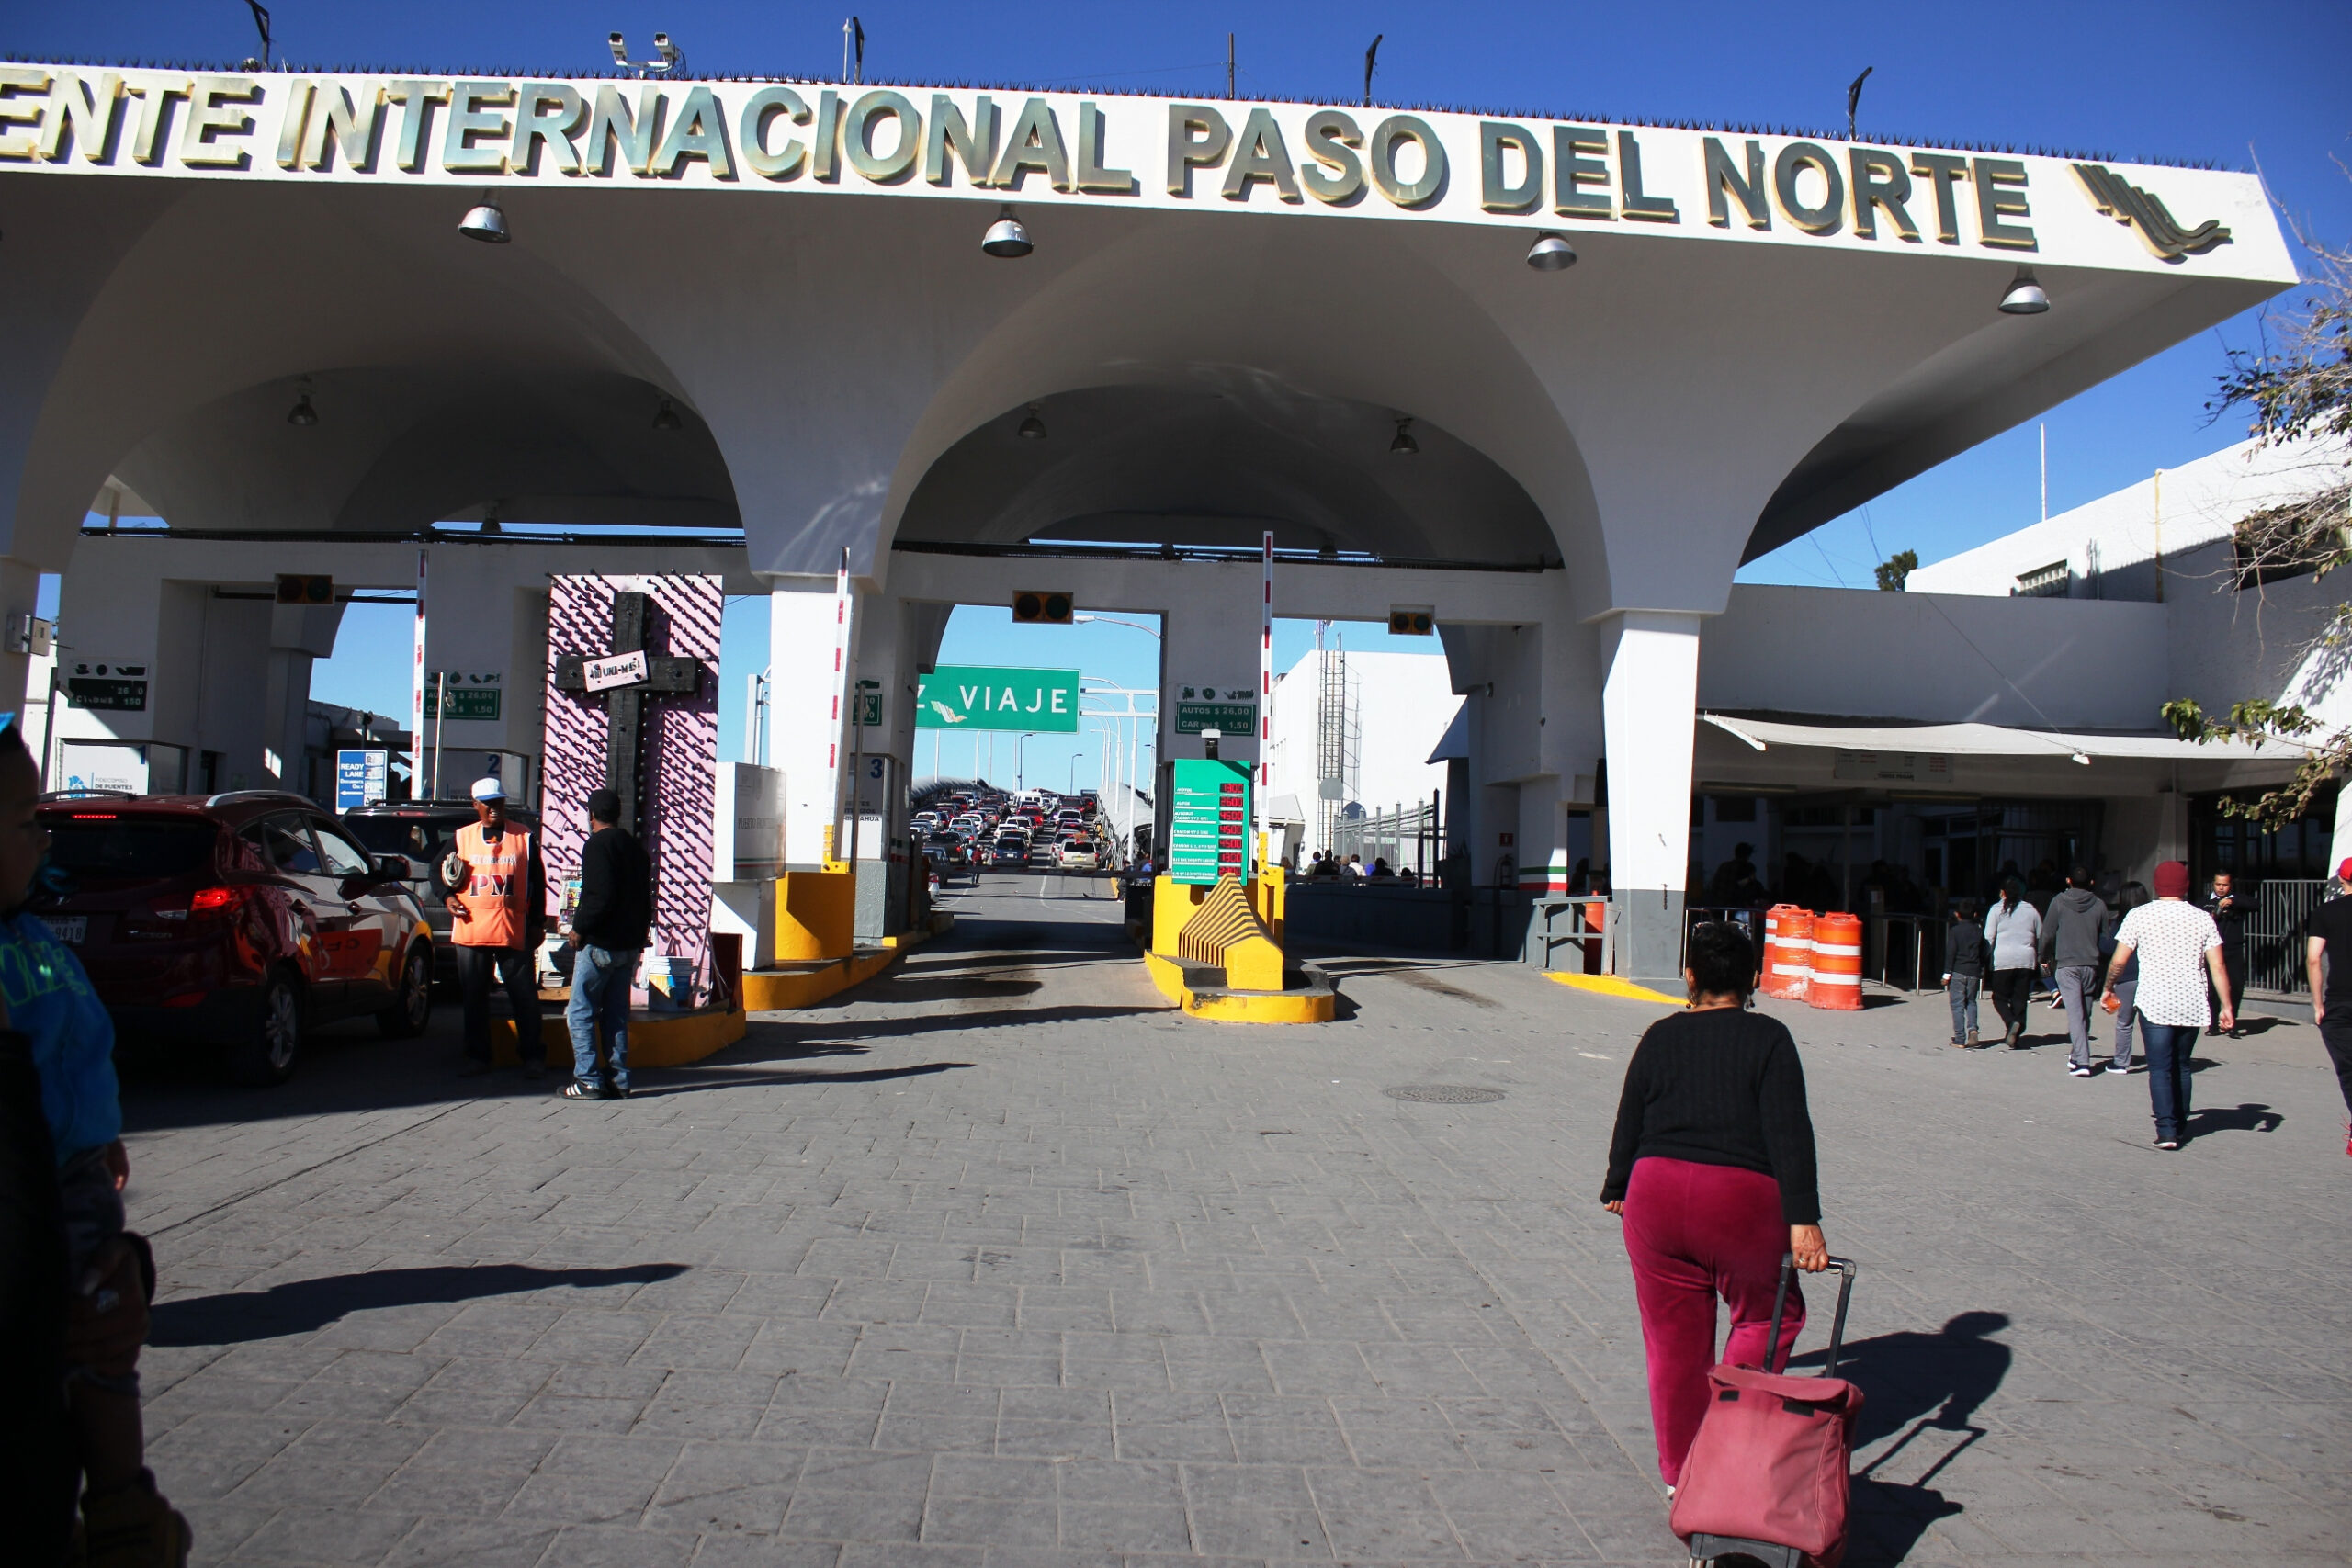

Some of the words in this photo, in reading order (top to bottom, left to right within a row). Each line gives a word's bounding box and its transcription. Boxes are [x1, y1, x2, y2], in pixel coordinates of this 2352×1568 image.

[277, 78, 1136, 195] INTERNACIONAL
[1167, 102, 1447, 209] PASO
[1480, 120, 1678, 222] DEL
[1703, 136, 2037, 251] NORTE
[959, 684, 1068, 714] VIAJE
[1182, 706, 1211, 716] AUTOS
[487, 753, 501, 774] 2
[870, 758, 883, 779] 3
[469, 874, 515, 897] PM
[55, 926, 83, 941] 9418
